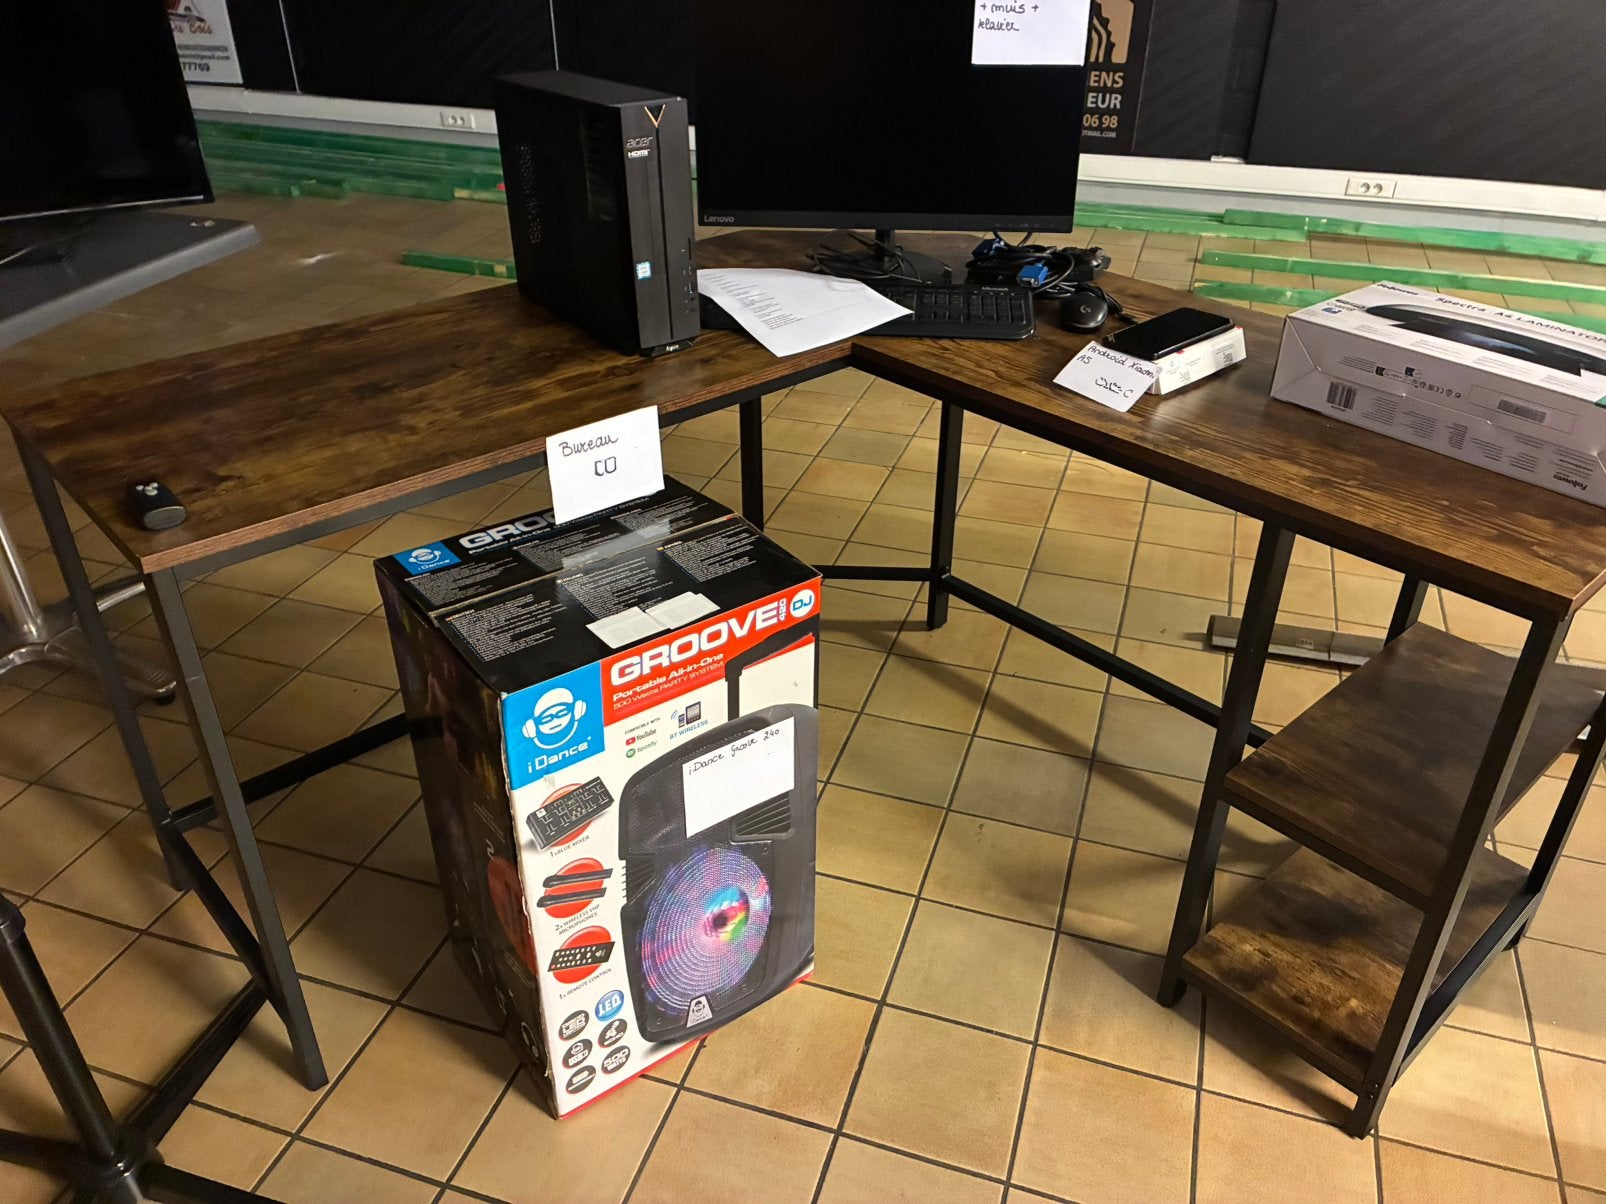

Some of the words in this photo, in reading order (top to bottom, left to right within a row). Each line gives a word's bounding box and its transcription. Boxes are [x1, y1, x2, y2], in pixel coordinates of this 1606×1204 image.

[991, 0, 1026, 14] muis
[1089, 71, 1124, 88] ENS
[1086, 92, 1122, 109] EUR
[1102, 115, 1118, 128] 98
[626, 137, 654, 148] acer
[704, 215, 735, 223] Lenovo
[1435, 297, 1486, 312] Spectra
[1087, 344, 1126, 367] Android
[559, 434, 619, 457] Bureau
[792, 595, 812, 612] DJ
[610, 602, 778, 686] GROOVE
[612, 676, 667, 702] Portable
[668, 653, 724, 681] All-in-One
[659, 678, 688, 692] PARTY
[689, 661, 724, 680] SYSTEM
[636, 729, 657, 740] YouTube
[679, 719, 709, 736] WIRELESS
[566, 981, 588, 995] REMOTE
[588, 968, 612, 983] CONTROL
[599, 994, 623, 1017] LED
[604, 1048, 629, 1067] 500
